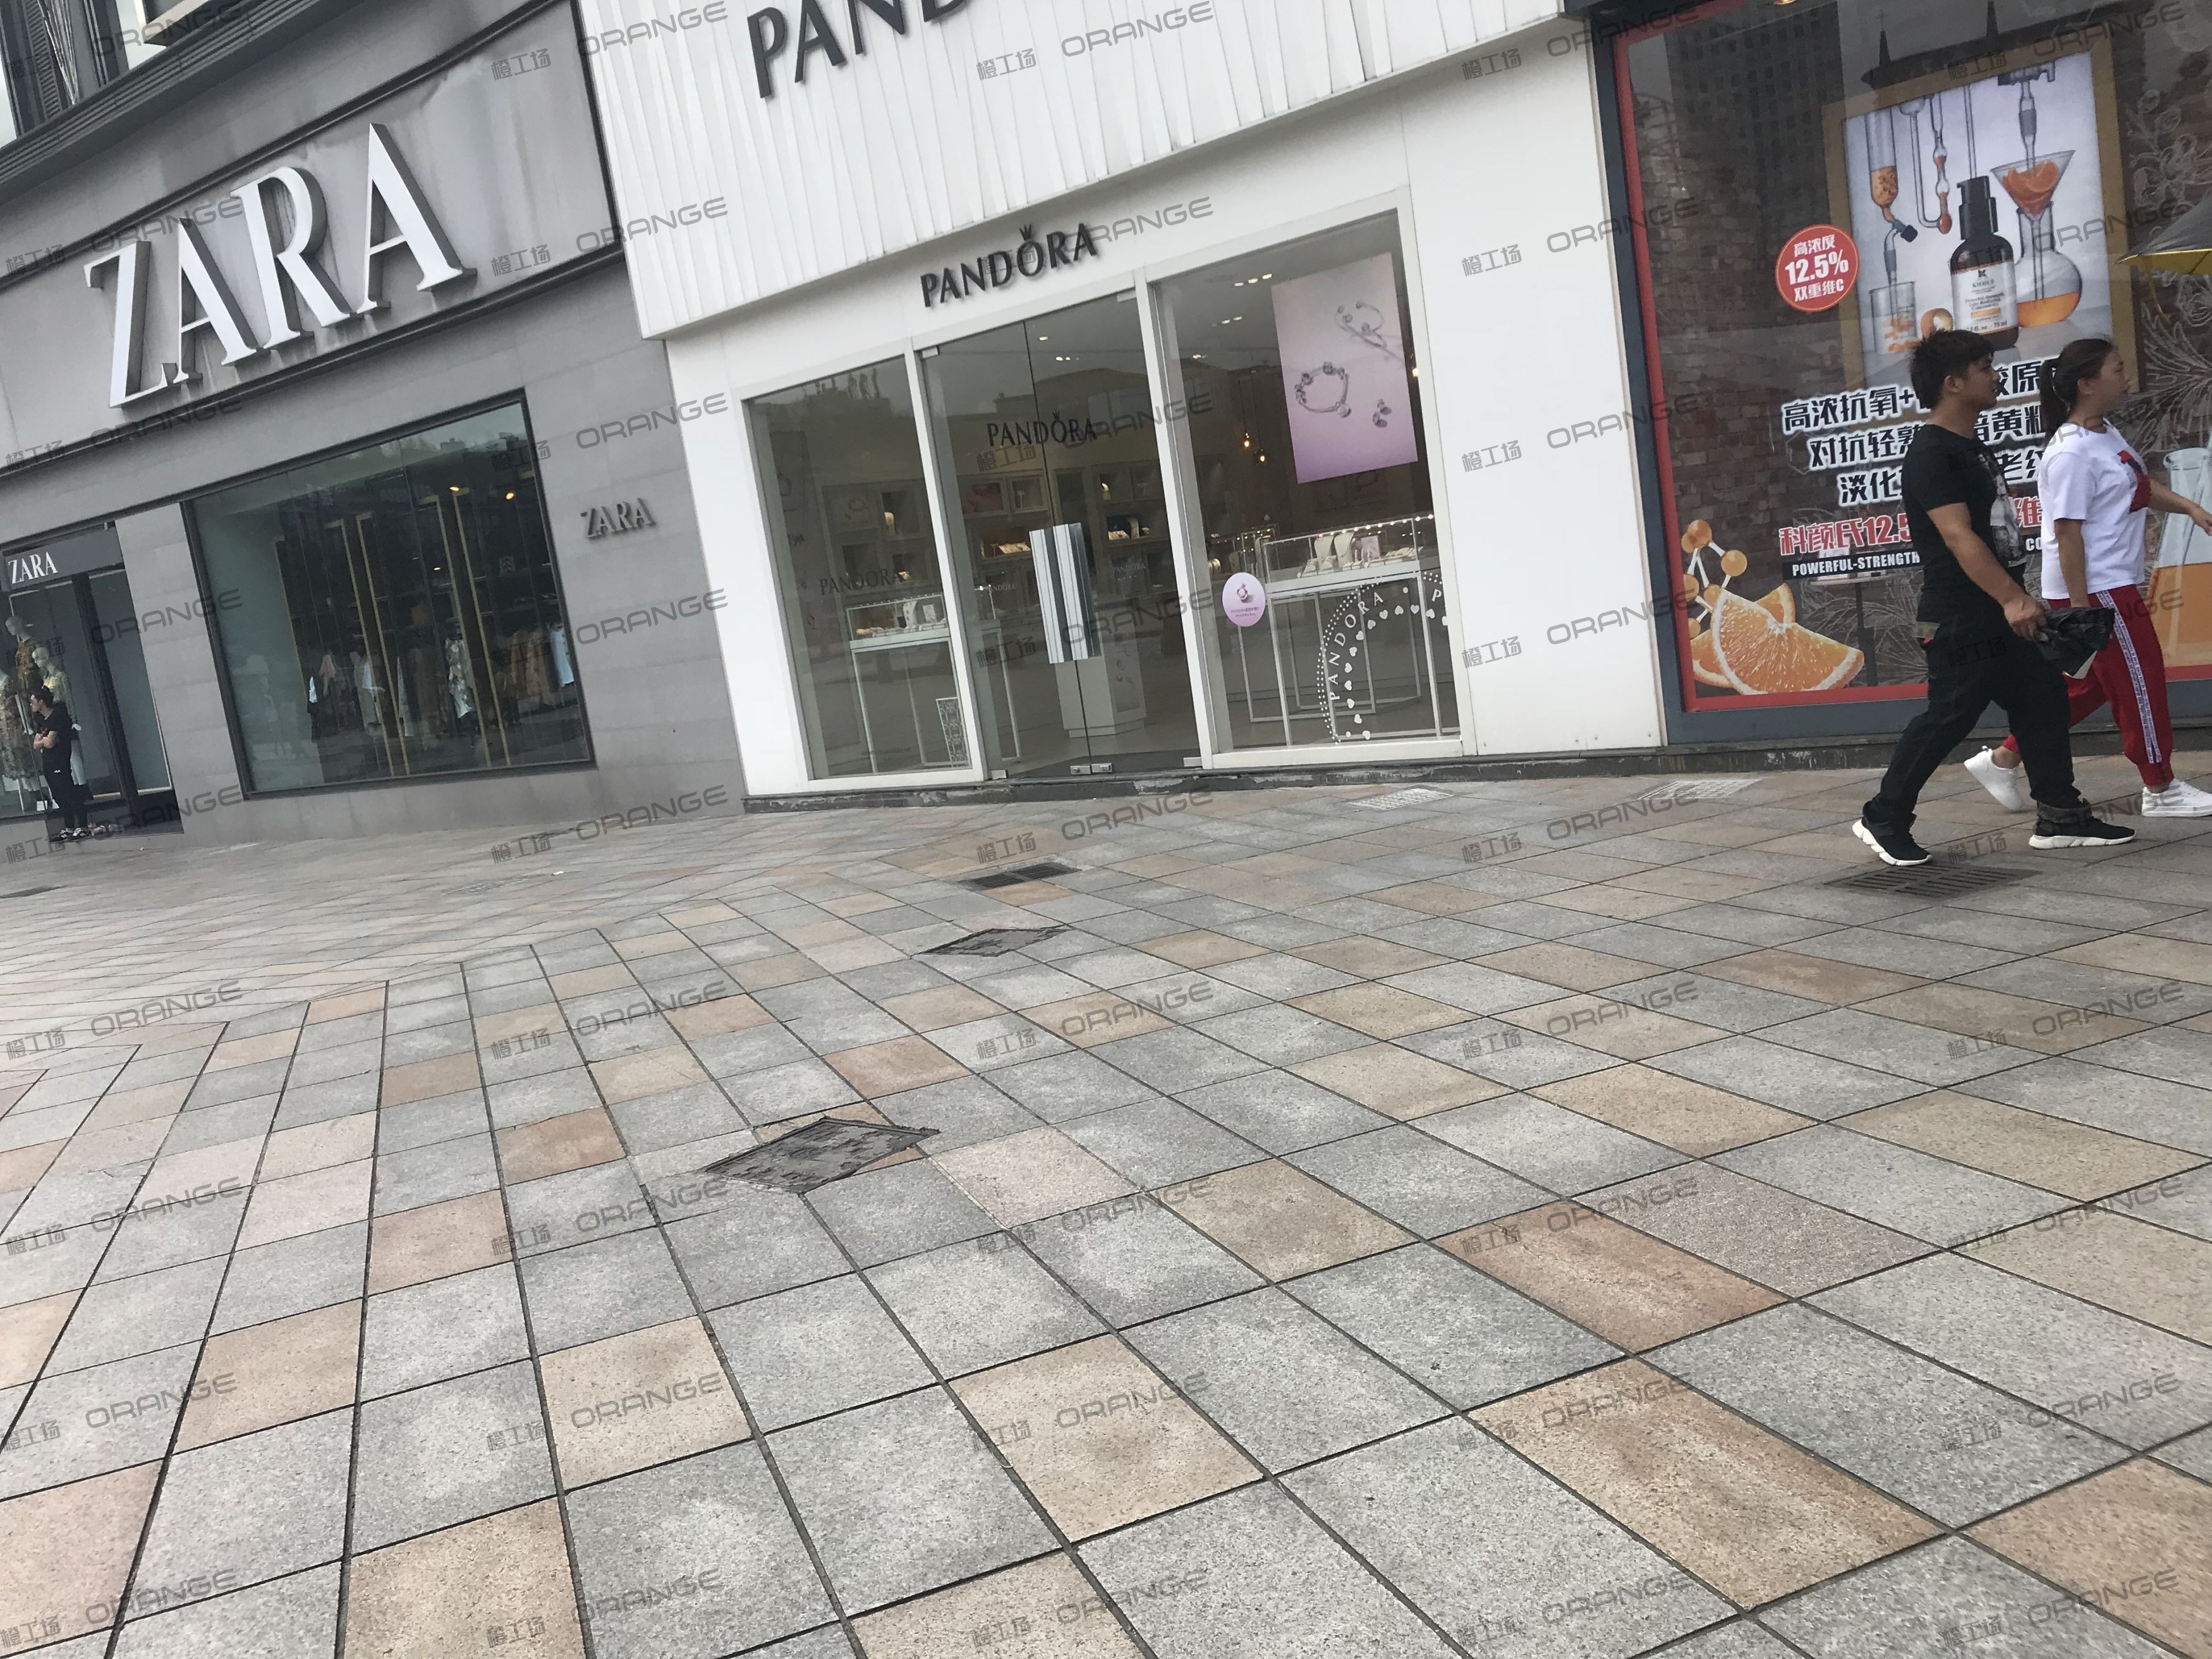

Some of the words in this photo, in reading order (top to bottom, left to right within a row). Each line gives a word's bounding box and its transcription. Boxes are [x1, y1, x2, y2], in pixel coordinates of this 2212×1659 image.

[1794, 234, 1836, 257] 高浓度
[84, 123, 475, 408] ZARA
[920, 223, 1097, 307] PANDORA
[1785, 250, 1849, 284] 12.5%
[1794, 279, 1844, 302] 双重维C
[987, 411, 1098, 447] PANDORA
[580, 497, 657, 540] ZARA
[8, 551, 59, 585] ZARA
[1792, 551, 1920, 577] POWERFUL-STRENGTH
[1327, 591, 1384, 701] PANDORA
